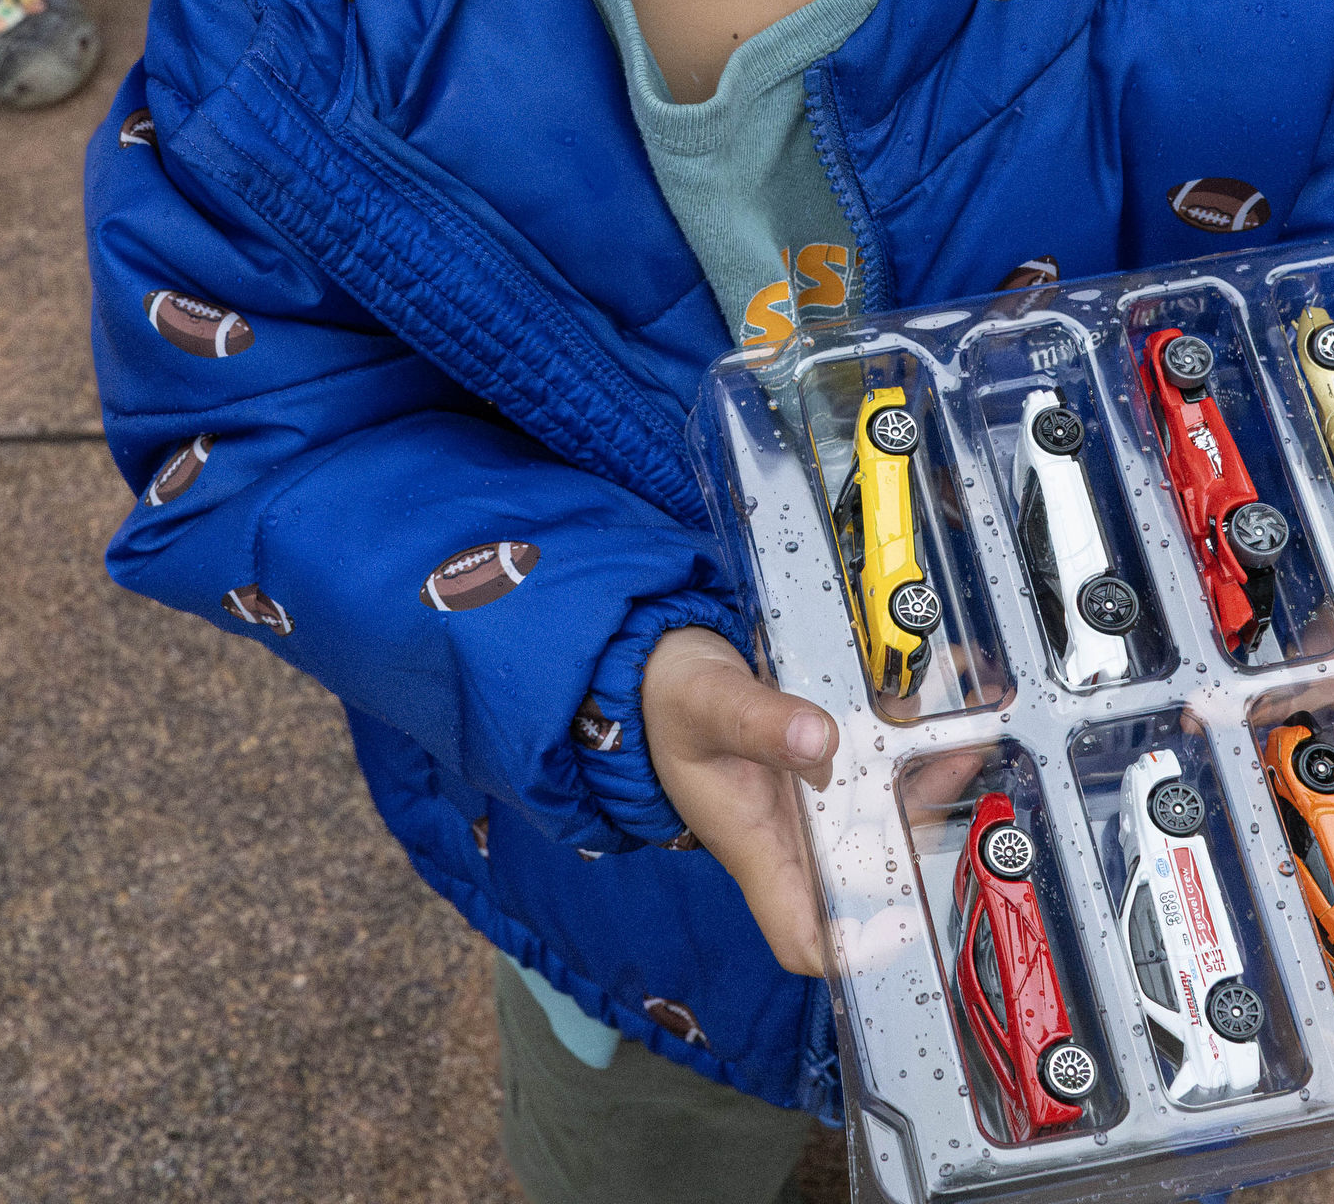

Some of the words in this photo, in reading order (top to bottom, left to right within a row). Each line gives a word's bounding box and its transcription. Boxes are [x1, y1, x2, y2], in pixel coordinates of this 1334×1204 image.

[1181, 868, 1194, 894] crew
[1160, 891, 1183, 926] 368
[1188, 897, 1206, 930] gravel
[1206, 961, 1227, 974] the
